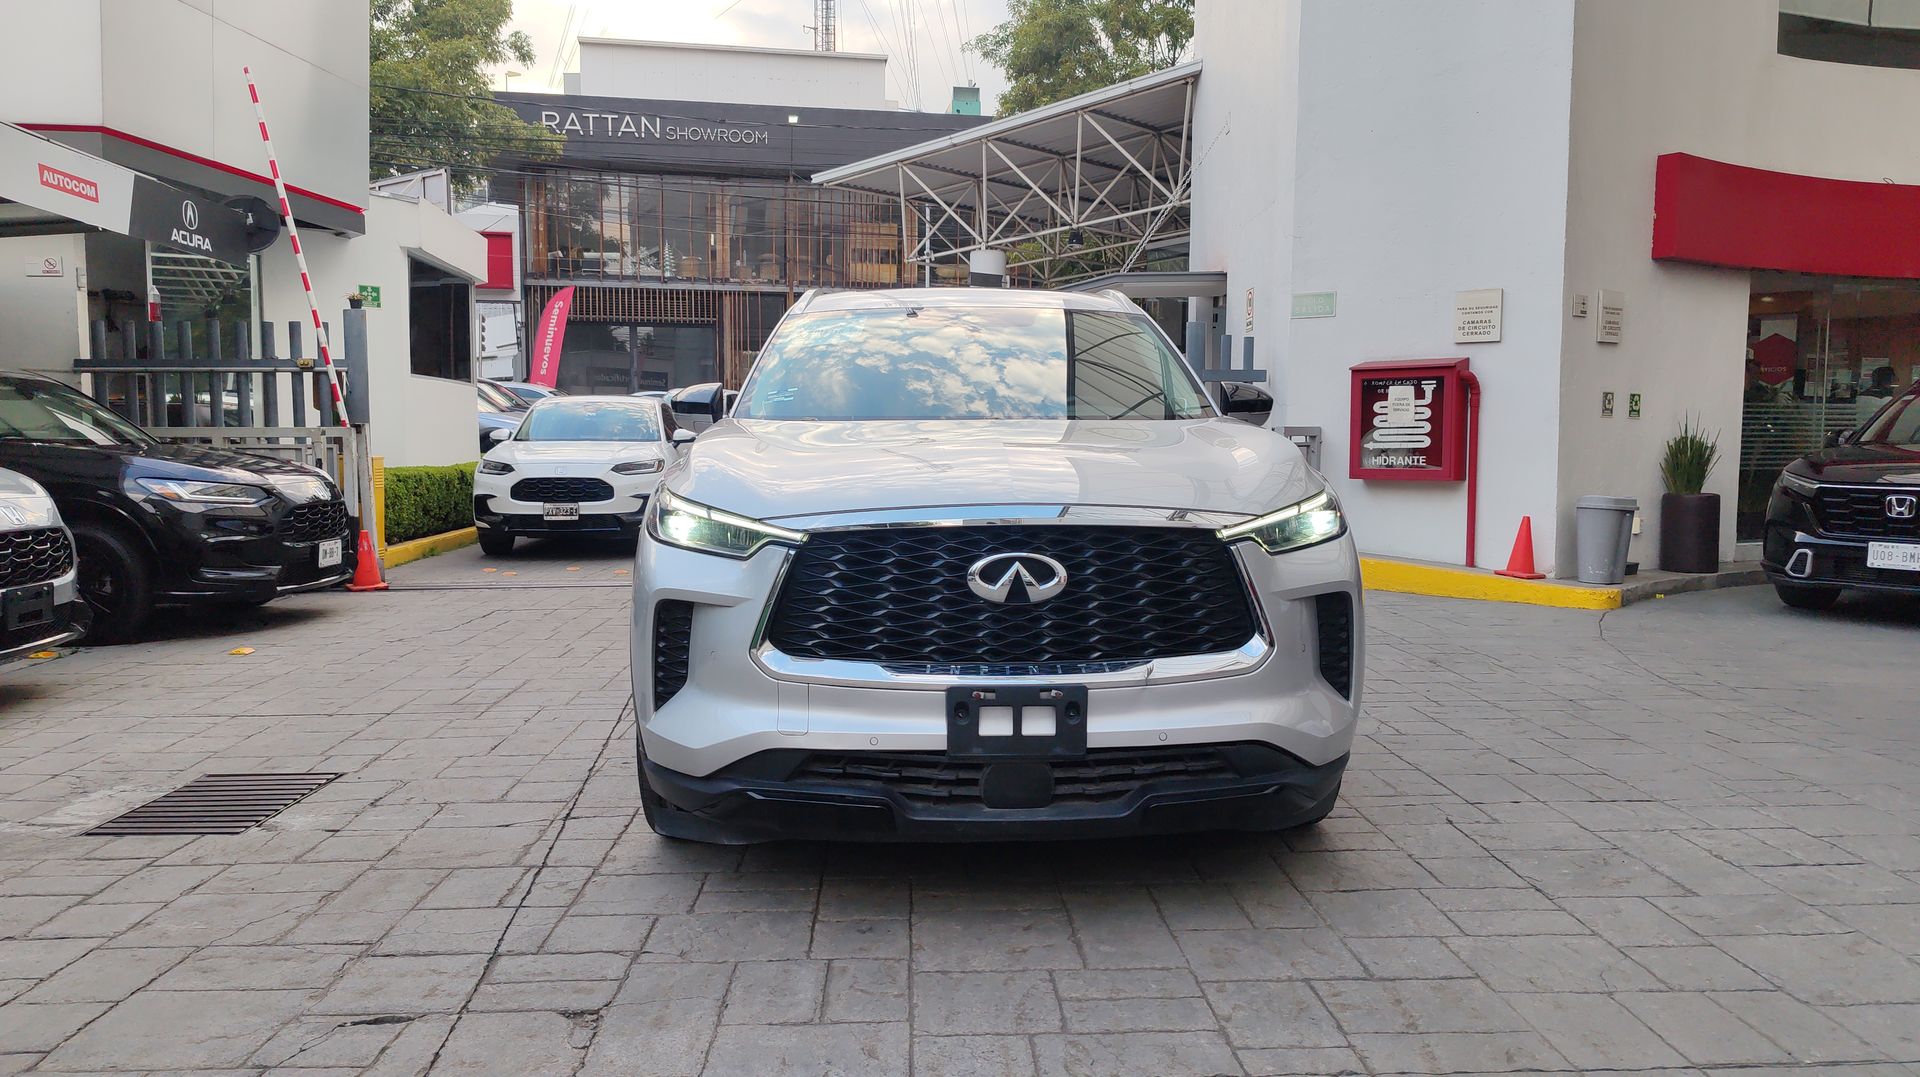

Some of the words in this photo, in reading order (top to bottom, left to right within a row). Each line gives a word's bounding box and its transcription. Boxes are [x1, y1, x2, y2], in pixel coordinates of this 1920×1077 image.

[541, 111, 661, 139] RATTAN
[665, 126, 768, 145] SHOWROOM
[43, 169, 96, 198] AUTOCOM
[171, 228, 213, 252] ACURA
[540, 300, 564, 376] Seminuevos
[1371, 455, 1427, 466] HIDRANTE
